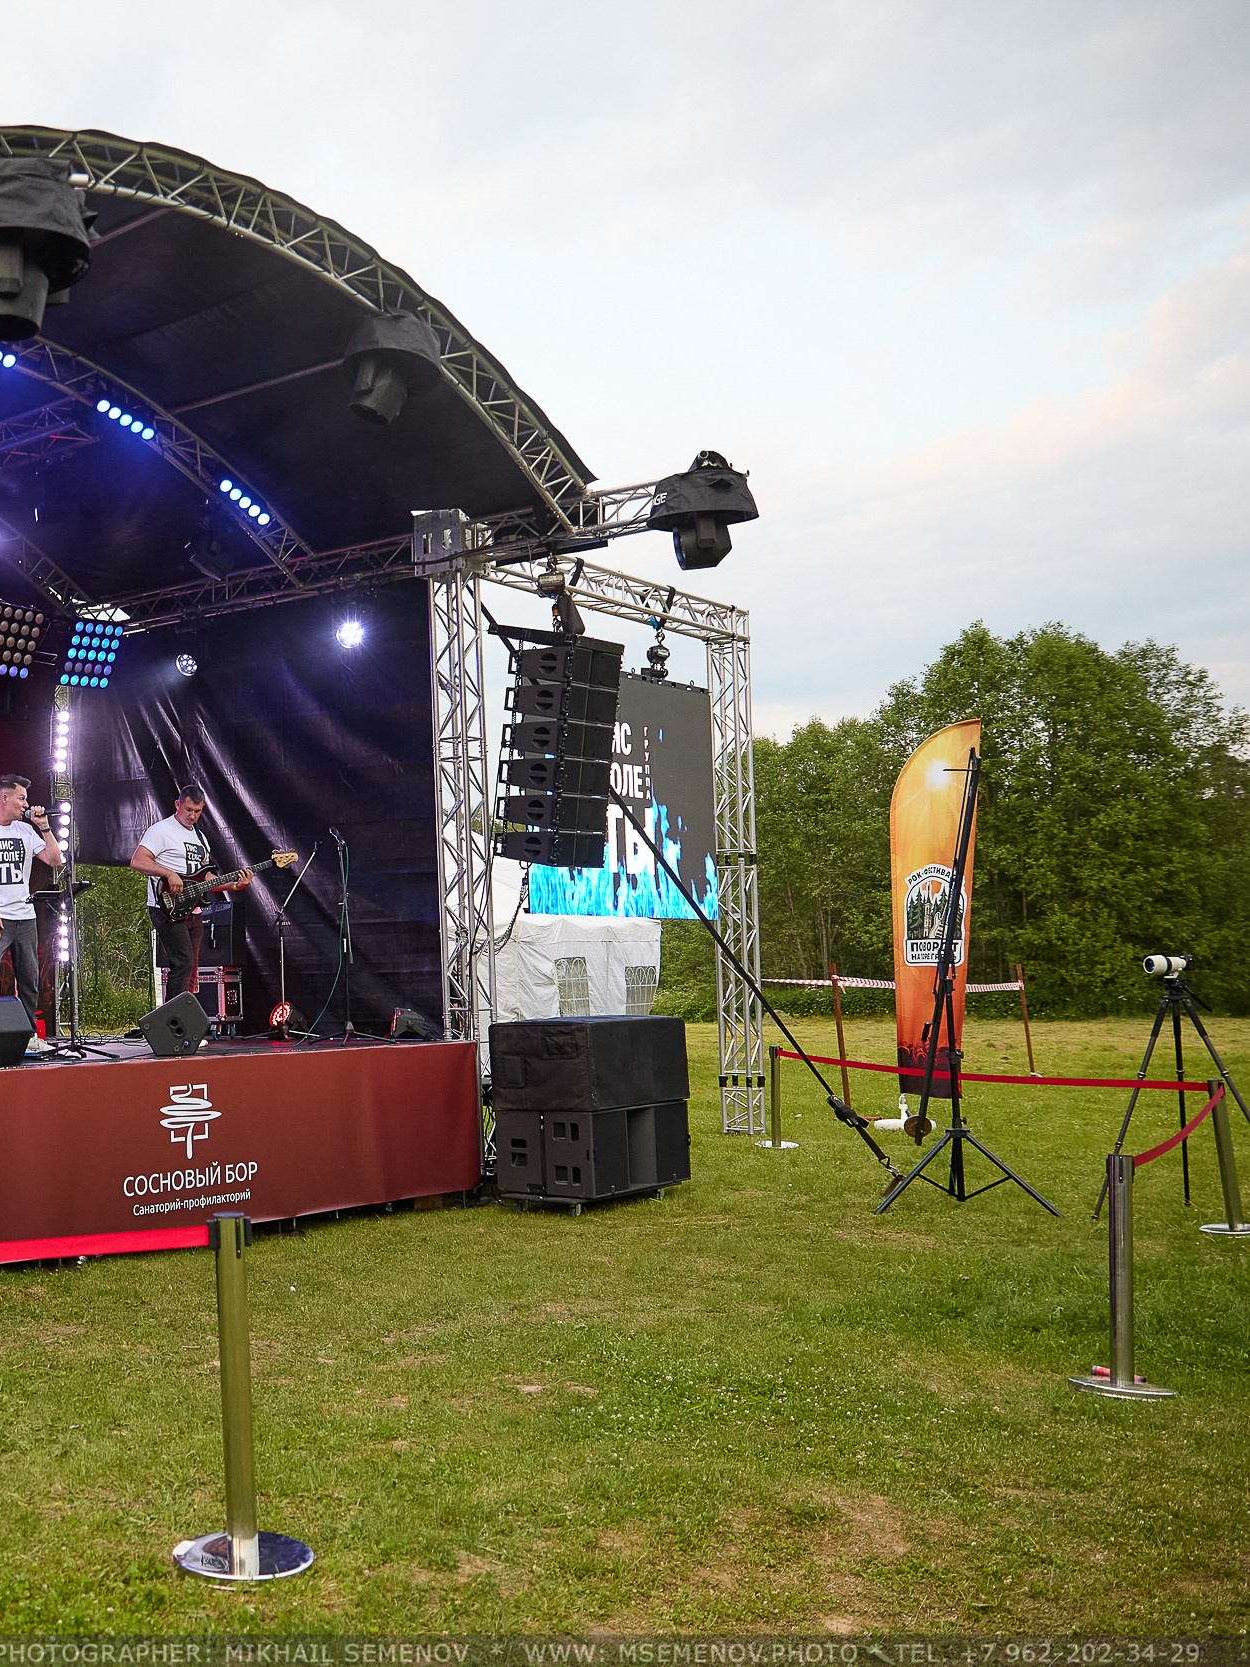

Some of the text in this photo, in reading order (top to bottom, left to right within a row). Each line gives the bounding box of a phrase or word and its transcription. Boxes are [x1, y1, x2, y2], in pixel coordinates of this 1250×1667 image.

[123, 1160, 258, 1197] СОСНОВЫЙ БОР
[133, 1188, 251, 1216] Санаторий-профилакторий
